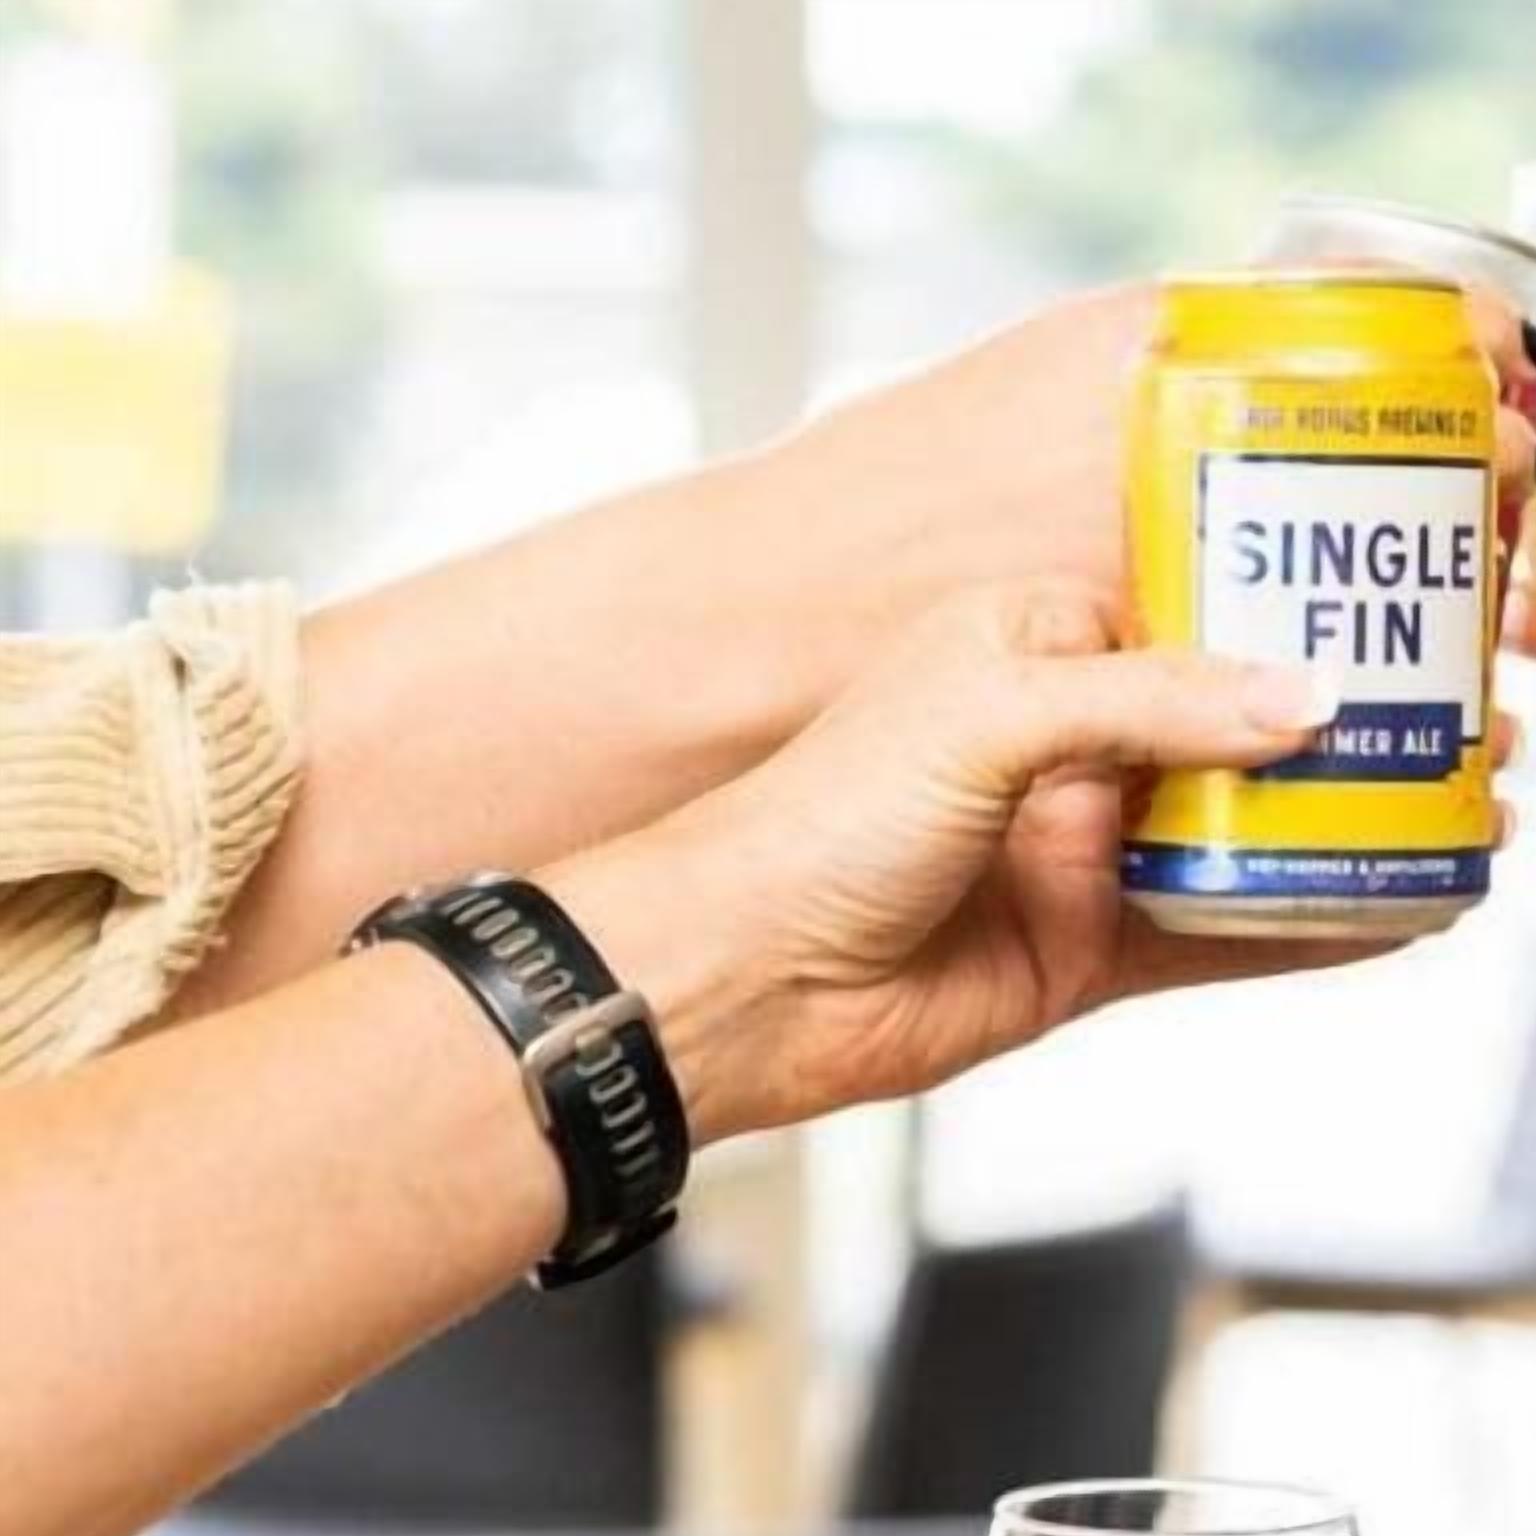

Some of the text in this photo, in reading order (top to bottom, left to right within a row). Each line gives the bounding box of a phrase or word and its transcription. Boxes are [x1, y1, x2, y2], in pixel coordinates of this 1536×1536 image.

[1230, 520, 1476, 589] SINGLE
[1305, 601, 1422, 664] FIN
[1402, 726, 1442, 757] ALE
